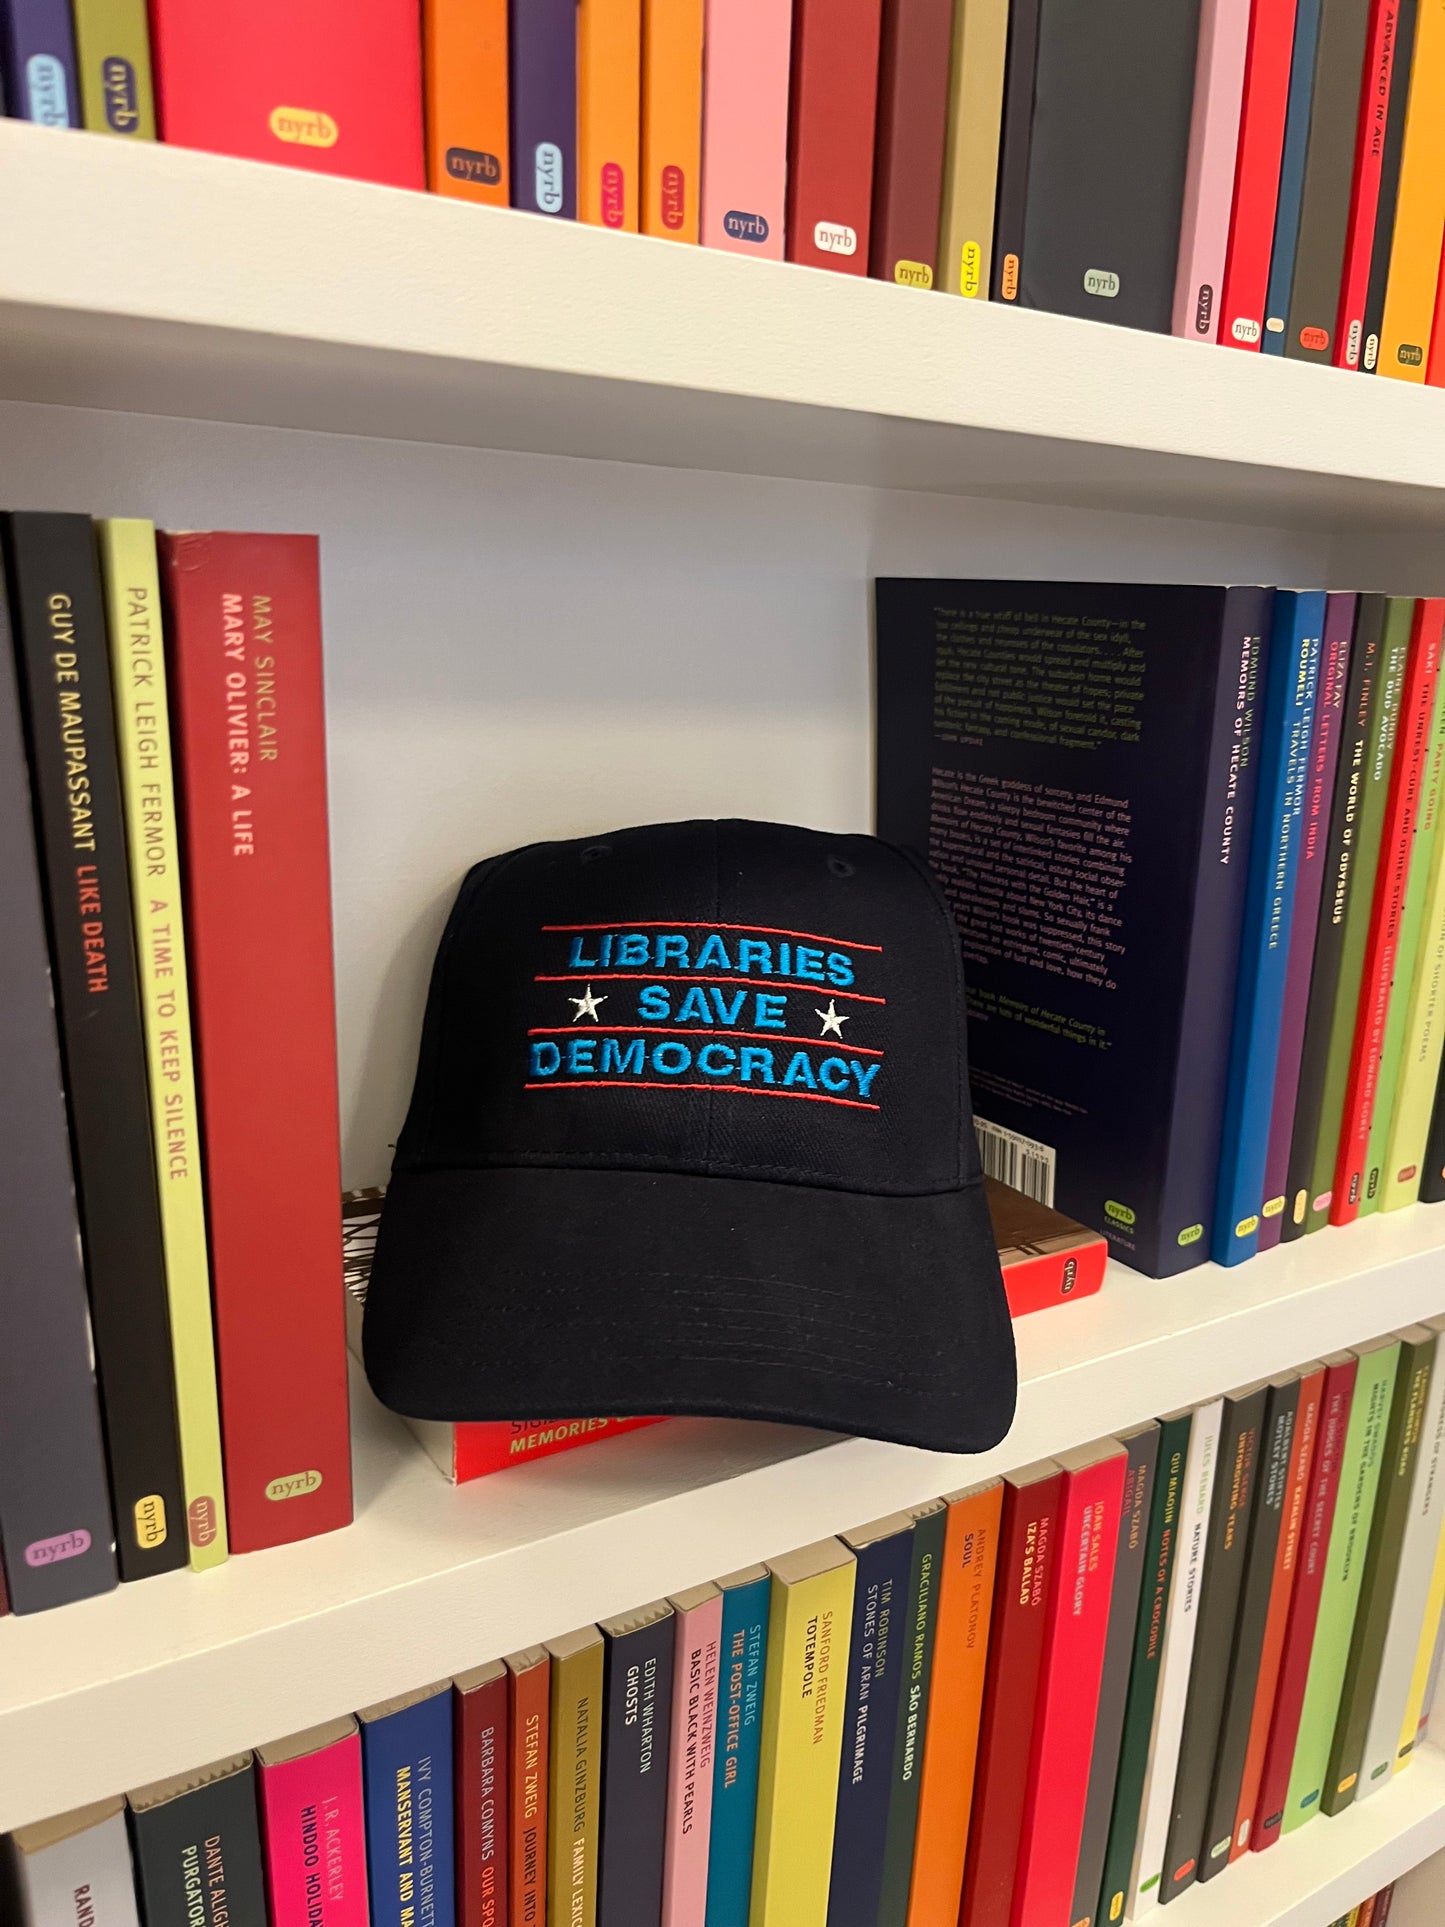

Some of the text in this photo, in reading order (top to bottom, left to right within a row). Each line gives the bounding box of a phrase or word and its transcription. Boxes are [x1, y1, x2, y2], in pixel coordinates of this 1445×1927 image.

[104, 64, 138, 127] nyrb
[1371, 11, 1395, 157] ADVANCED IN AGE
[277, 116, 332, 142] nyrb
[450, 156, 497, 180] nyrb
[537, 151, 560, 206] nyrb
[602, 170, 624, 223] nyrb
[663, 173, 685, 224] nyrb
[728, 215, 766, 240] nyrb
[819, 228, 852, 251] nyrb
[899, 266, 930, 286] nyrb
[962, 247, 977, 292] nyrb
[1003, 258, 1017, 295] nyrb
[1088, 274, 1116, 295] nyrb
[1198, 288, 1210, 331] nyrb
[1235, 321, 1258, 341] nyrb
[1347, 323, 1359, 361] nyrb
[1365, 336, 1376, 366] nyrb
[1399, 347, 1422, 364] nyrb
[252, 596, 278, 762] MAY SINCLAIR
[1336, 641, 1348, 679] ELIZA
[1425, 642, 1438, 674] SAKI
[222, 593, 254, 856] MARY OLIVIER: A LIFE
[1239, 636, 1261, 767] EDMUND WILSON
[1292, 638, 1320, 816] PATRICK FERMOR
[1220, 636, 1252, 865] MEMOIRS OF HECATE COUNTY
[1306, 641, 1339, 859] ORIGINAL LETTERS FROM INDIA
[1373, 680, 1395, 781] DUD AVOCADO
[50, 594, 109, 993] GUY DE MAUPASSANT LIKE DEATH
[1269, 638, 1311, 949] ROUMELI TRAVELS IN NORTHERN GREECE
[1332, 679, 1371, 925] FINLEY THE WORLD OF ODYSSEUS
[127, 586, 188, 1180] PATRICK LEIGH FERMOR A TIME TO KEEP SILENCE
[568, 934, 855, 986] LIBRARIES
[637, 985, 788, 1030] SAVE
[529, 1038, 881, 1098] DEMOCRACY
[1108, 1203, 1133, 1221] nyrb
[1179, 1225, 1202, 1244] nyrb
[1237, 1217, 1257, 1235] nyrb
[1063, 1260, 1076, 1292] nyrb
[510, 1417, 608, 1455] MEMORIES
[1169, 1452, 1181, 1474] QIU
[271, 1473, 317, 1496] nyrb
[1133, 1464, 1147, 1505] MAGDA
[1164, 1475, 1178, 1524] MIAOJIN
[32, 1533, 85, 1561] nyrb
[139, 1501, 164, 1543] nyrb
[190, 1500, 215, 1542] nyrb
[961, 1532, 975, 1569] SOUL
[1031, 1517, 1050, 1607] MAGDA SZABÓ
[1072, 1505, 1093, 1617] UNCERTAIN GLORY
[1088, 1533, 1102, 1573] SALES
[1159, 1529, 1172, 1568] NOTES
[1184, 1522, 1202, 1613] NATURE STORIES
[915, 1553, 933, 1632] GRACILIANO
[966, 1528, 987, 1650] ANDREY PLATONOV
[1018, 1558, 1033, 1606] BALLAD
[1156, 1569, 1166, 1584] OF
[874, 1578, 893, 1679] TIM ROBINSON
[743, 1624, 762, 1727] STEFAN ZWEIG
[801, 1615, 819, 1699] TOTEMPOLE
[812, 1611, 833, 1745] SANFORD FRIEDMAN
[910, 1634, 926, 1680] RAMOS
[624, 1665, 640, 1727] GHOSTS
[699, 1640, 718, 1769] HELEN WEINZWEIG
[723, 1629, 746, 1789] THE POST-OFFICE GIRL
[851, 1584, 879, 1785] STONES OF ARAN PILGRIMAGE
[576, 1697, 590, 1760] NATALIA
[639, 1657, 657, 1775] EDITH WHARTON
[682, 1648, 702, 1836] BASIC BLACK WITH PEARLS
[481, 1726, 495, 1798] BARBARA
[902, 1712, 919, 1781] BERNARDO
[523, 1714, 540, 1922] STEFAN ZWEIG JOURNEY INTO
[573, 1760, 588, 1834] GINZBURG
[300, 1804, 320, 1867] HINDOO
[396, 1766, 414, 1902] MANSERVANT AND
[417, 1756, 435, 1927] IVY COMPTON-BURNETT
[481, 1800, 495, 1862] COMYNS
[204, 1834, 225, 1888] DANTE
[324, 1829, 344, 1901] ACKERLEY
[481, 1866, 495, 1898] OUR
[571, 1837, 586, 1891] FAMILY
[73, 1884, 96, 1927] RAND
